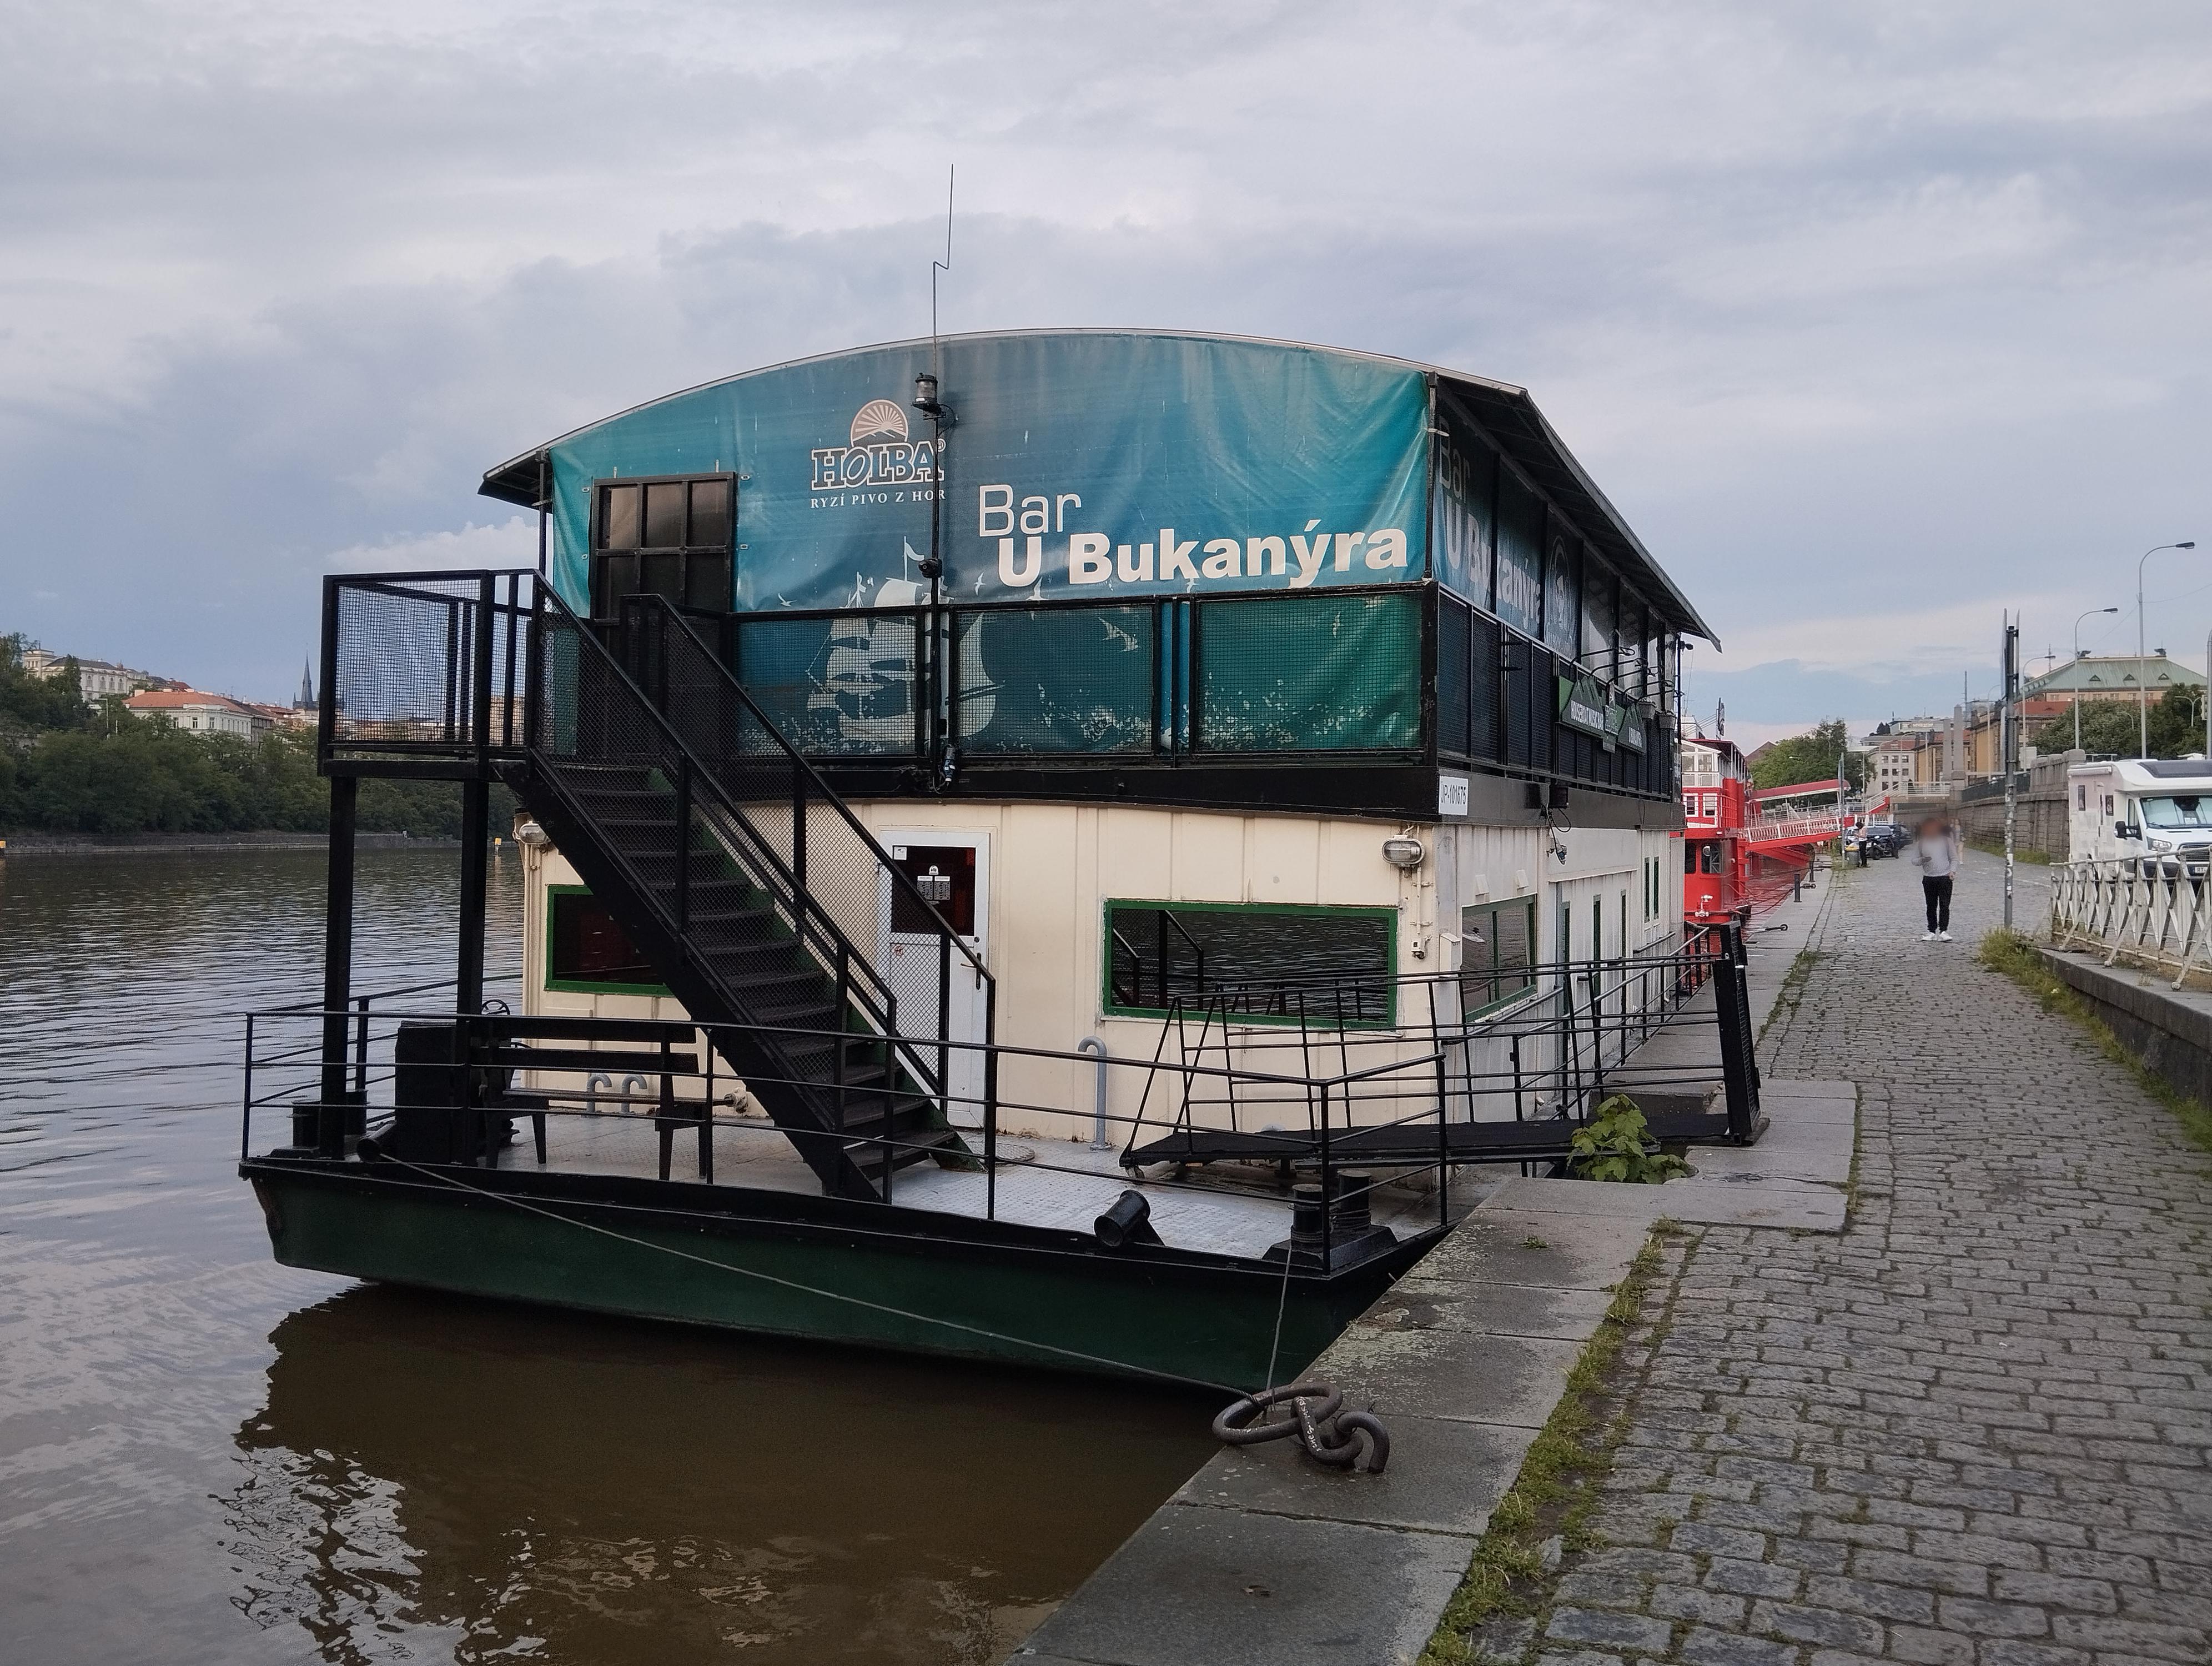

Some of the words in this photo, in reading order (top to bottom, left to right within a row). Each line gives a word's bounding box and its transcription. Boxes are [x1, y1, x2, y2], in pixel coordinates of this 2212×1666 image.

[811, 440, 944, 490] HOLBA
[1439, 415, 1470, 503] Bar
[810, 493, 845, 509] RYZÍ
[852, 492, 888, 505] PIVO
[895, 491, 904, 503] Z
[912, 489, 946, 501] HOR
[978, 484, 1082, 537] Bar
[999, 536, 1042, 586] U
[1069, 519, 1408, 589] Bukanýra
[1446, 494, 1461, 570] U
